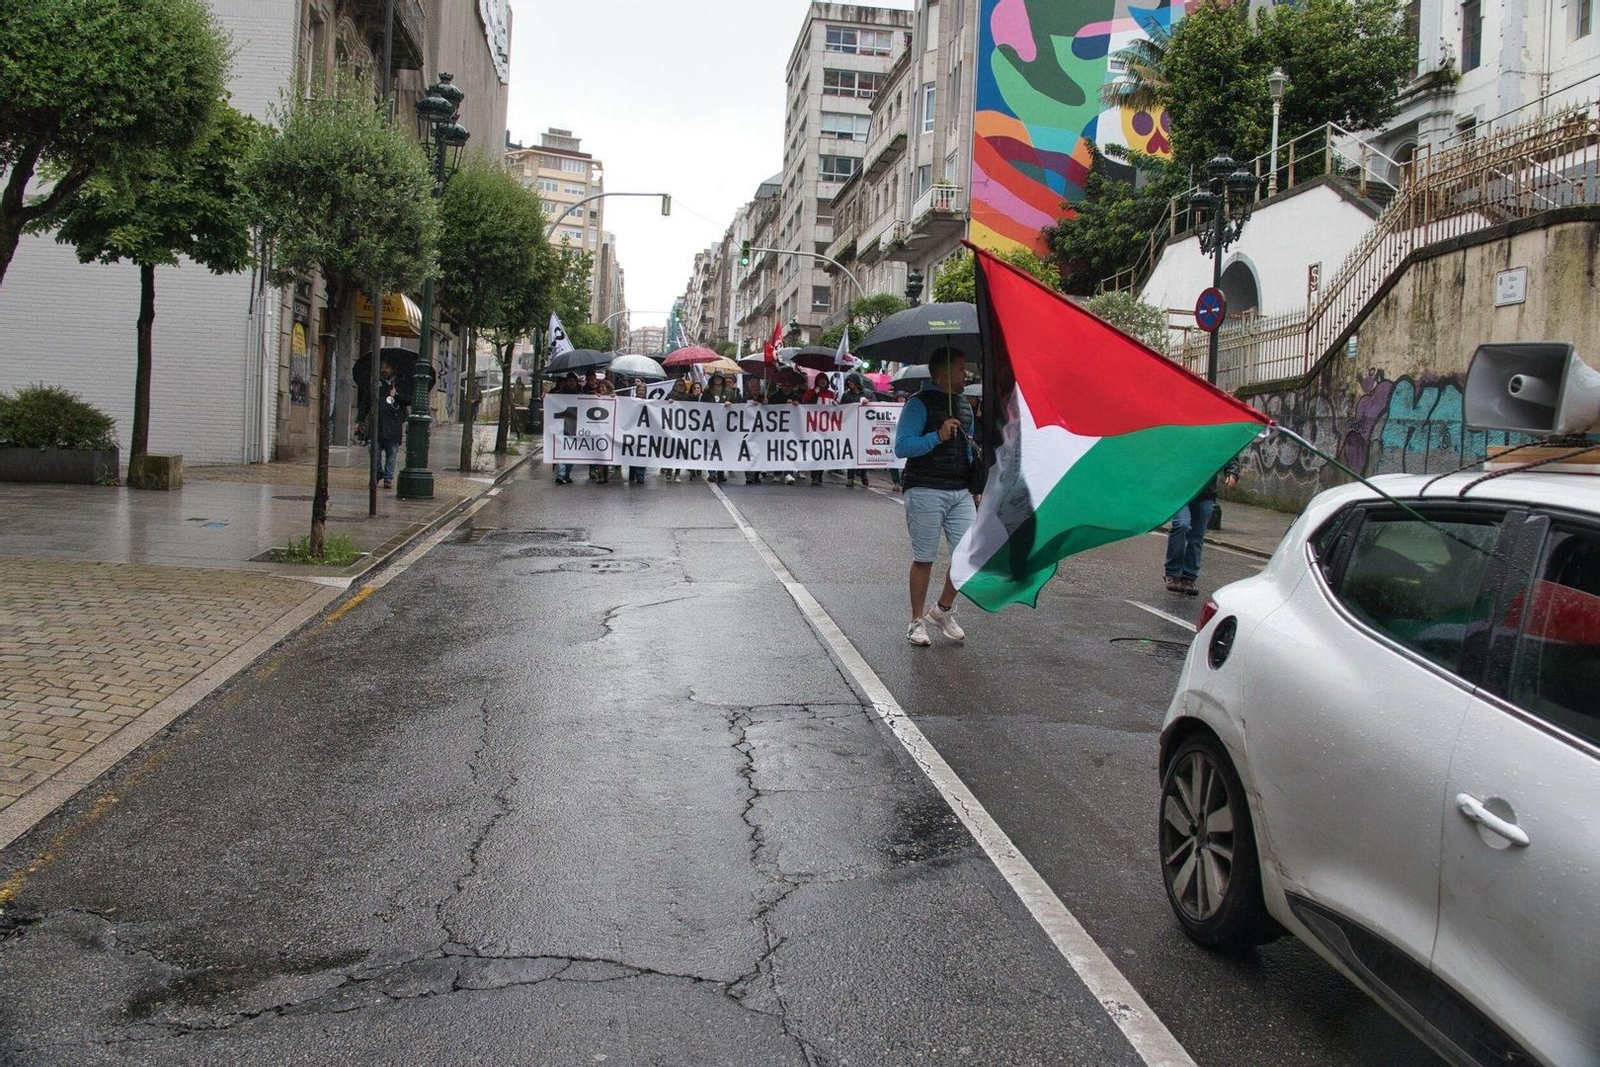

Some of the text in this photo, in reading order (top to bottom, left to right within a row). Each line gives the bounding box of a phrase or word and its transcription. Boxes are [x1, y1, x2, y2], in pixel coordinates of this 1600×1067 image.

[637, 405, 843, 432] A NOSA CLASE NON
[578, 427, 591, 437] de
[563, 437, 609, 452] MAIO
[621, 433, 854, 461] RENUNCIA Á HISTORIA
